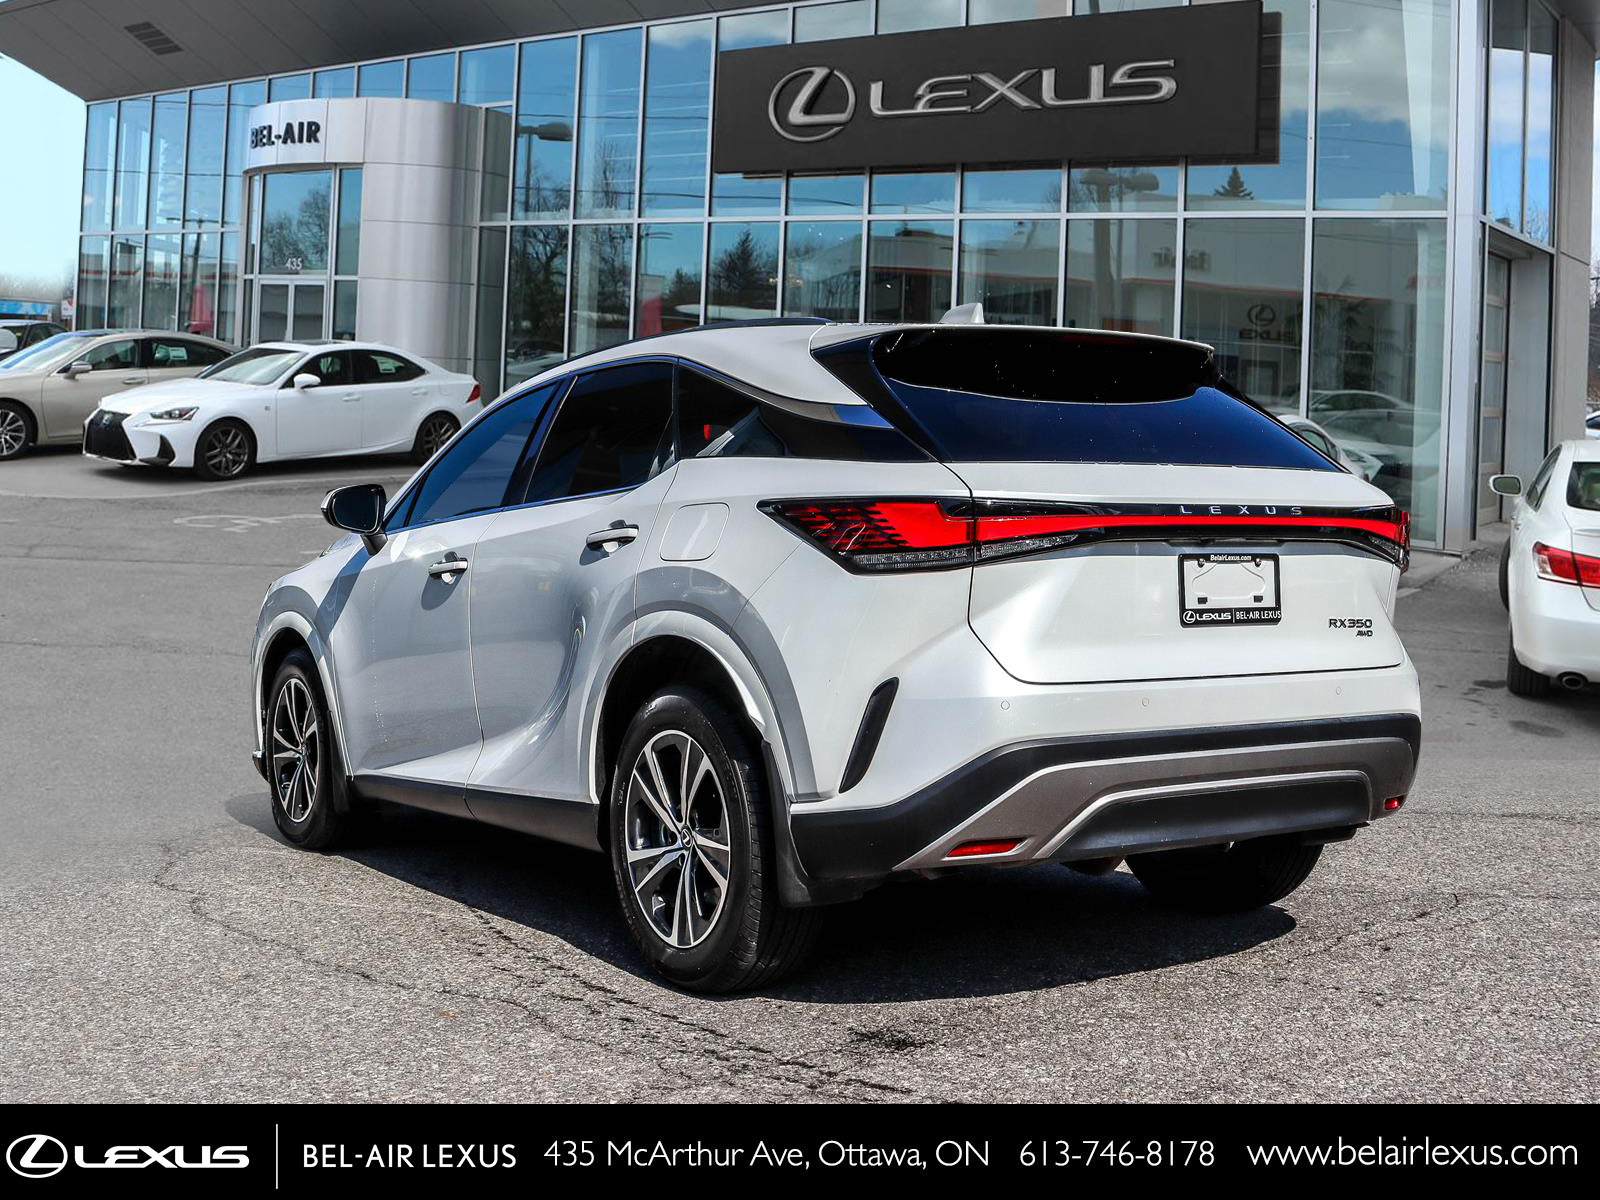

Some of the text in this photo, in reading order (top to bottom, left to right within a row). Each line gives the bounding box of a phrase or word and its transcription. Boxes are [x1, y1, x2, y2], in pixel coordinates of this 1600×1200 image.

[870, 59, 1178, 118] LEXUS
[251, 121, 321, 149] BEL-AIR
[285, 257, 303, 270] 435
[1180, 505, 1303, 516] LEXUS
[1210, 554, 1252, 562] BelairLexus.com
[1196, 610, 1282, 621] LEXUS BEL-AIR LEXUS
[1328, 618, 1373, 629] RX350
